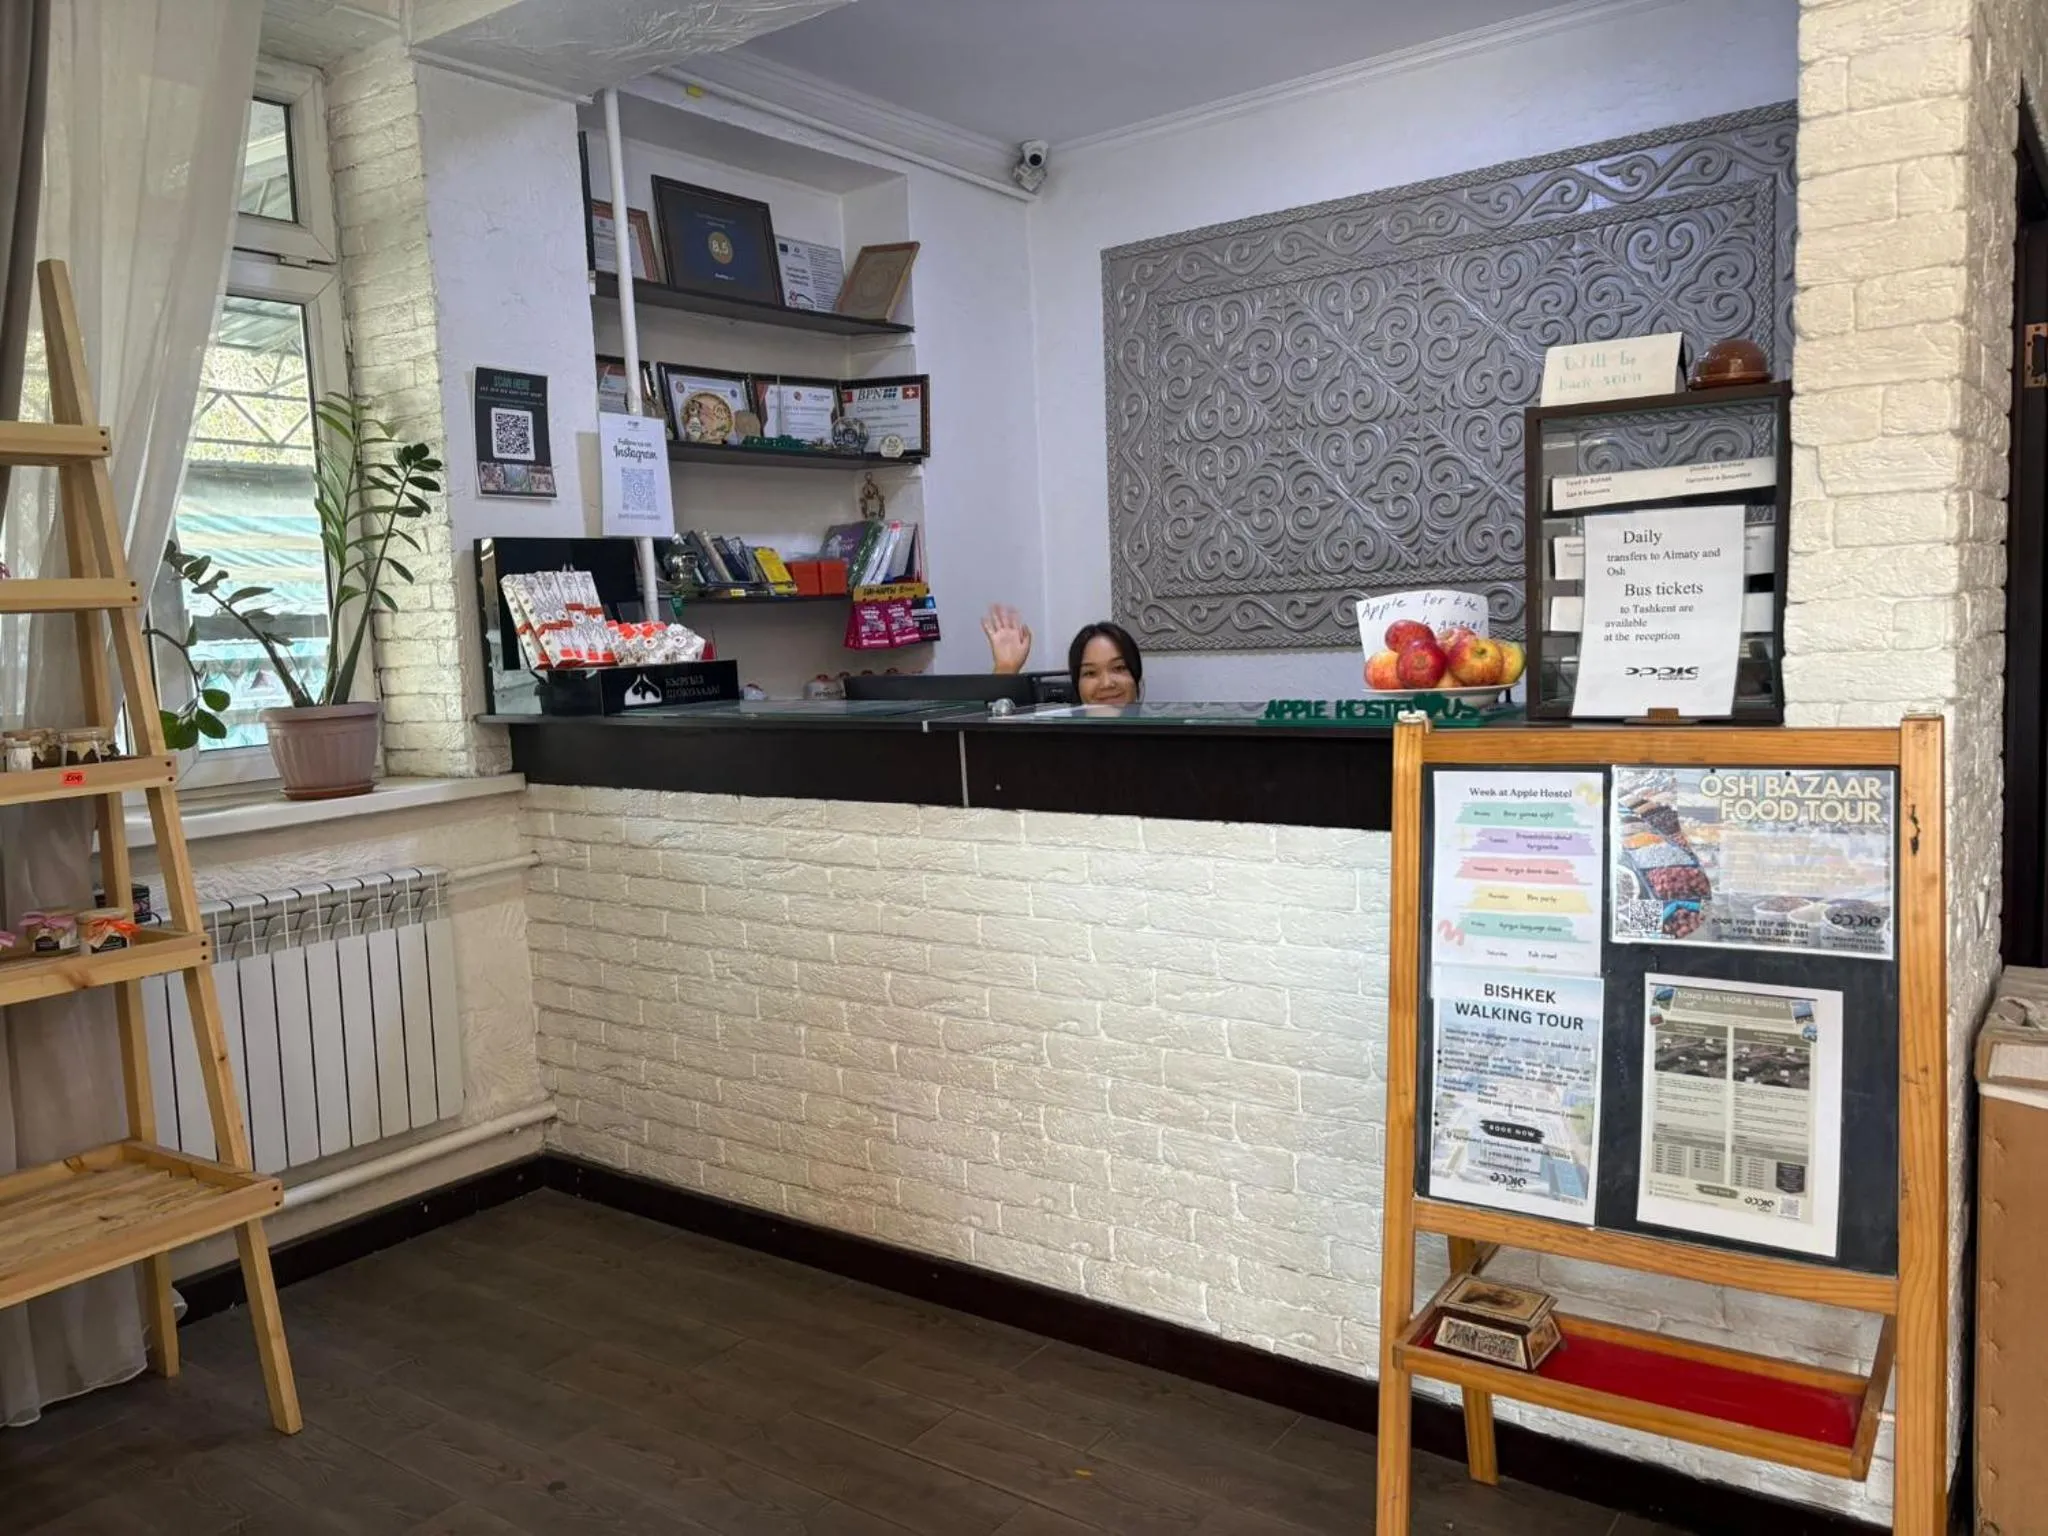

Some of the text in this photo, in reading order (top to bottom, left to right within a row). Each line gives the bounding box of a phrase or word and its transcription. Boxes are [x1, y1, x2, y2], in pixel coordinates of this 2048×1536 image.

[857, 388, 883, 401] BPN
[613, 445, 658, 463] Instagram
[1623, 529, 1663, 545] Daily
[1607, 548, 1721, 562] transfers to Almaty and
[1606, 566, 1626, 577] Osh
[1624, 581, 1704, 597] Bus tickets
[1362, 598, 1408, 621] Apple
[1423, 592, 1447, 606] for
[1620, 603, 1694, 614] to Tashkent are
[1604, 618, 1648, 628] available
[1603, 632, 1681, 643] at the reception
[1264, 698, 1328, 720] APPLE
[1469, 787, 1573, 799] Week at Apple Hostel
[1699, 775, 1884, 800] OSH BAZAAR
[1719, 798, 1882, 824] FOOD TOUR
[1483, 982, 1557, 1005] BISHKEK
[1455, 1001, 1585, 1032] WALKING TOUR
